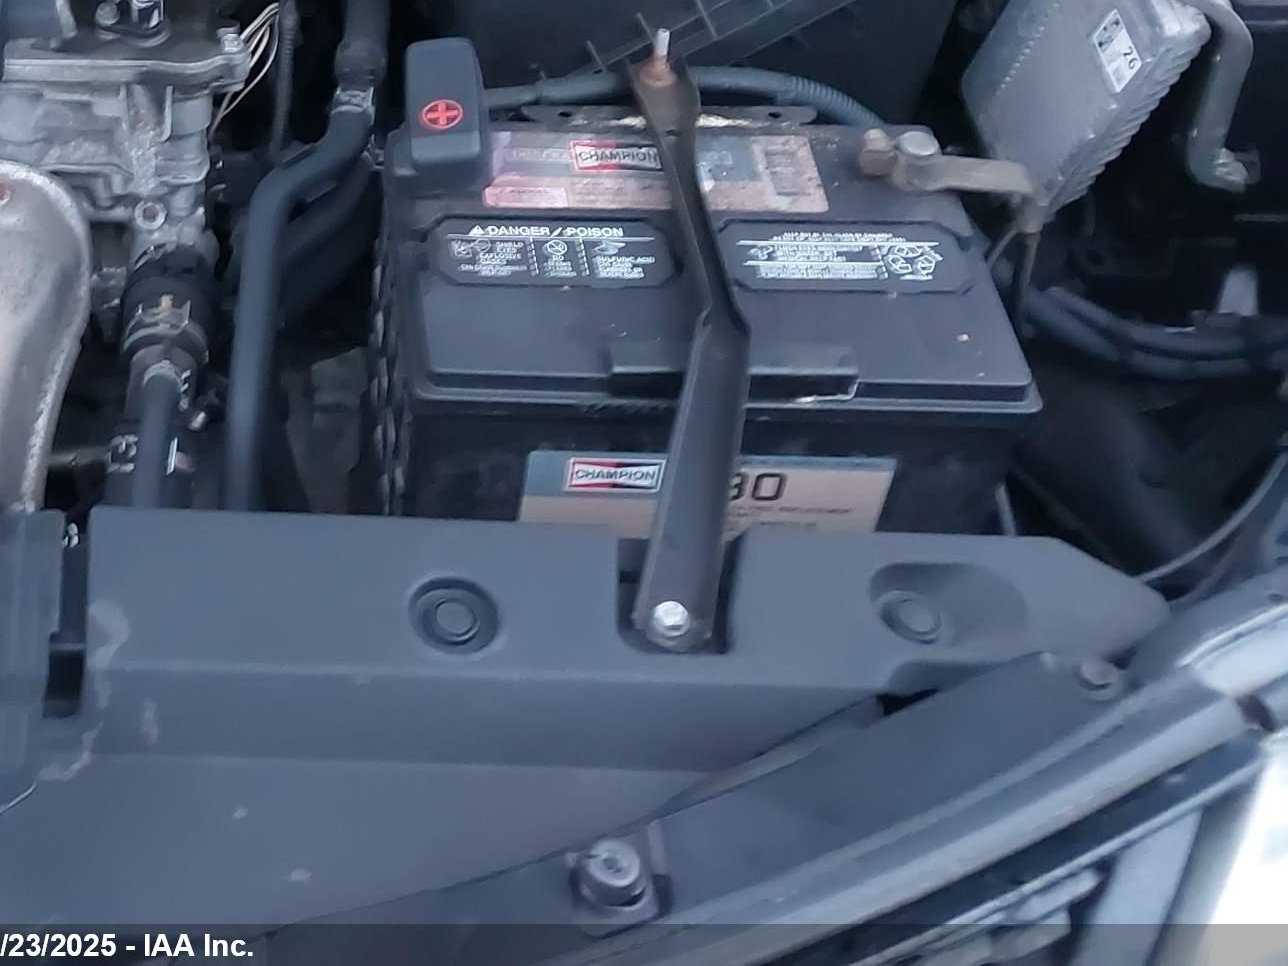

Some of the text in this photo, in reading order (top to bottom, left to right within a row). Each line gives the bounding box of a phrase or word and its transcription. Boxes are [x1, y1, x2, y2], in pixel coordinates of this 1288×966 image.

[577, 148, 658, 164] CHAMPION
[486, 225, 551, 237] DANGER
[562, 226, 624, 238] POISON
[575, 468, 657, 482] CHAMPION
